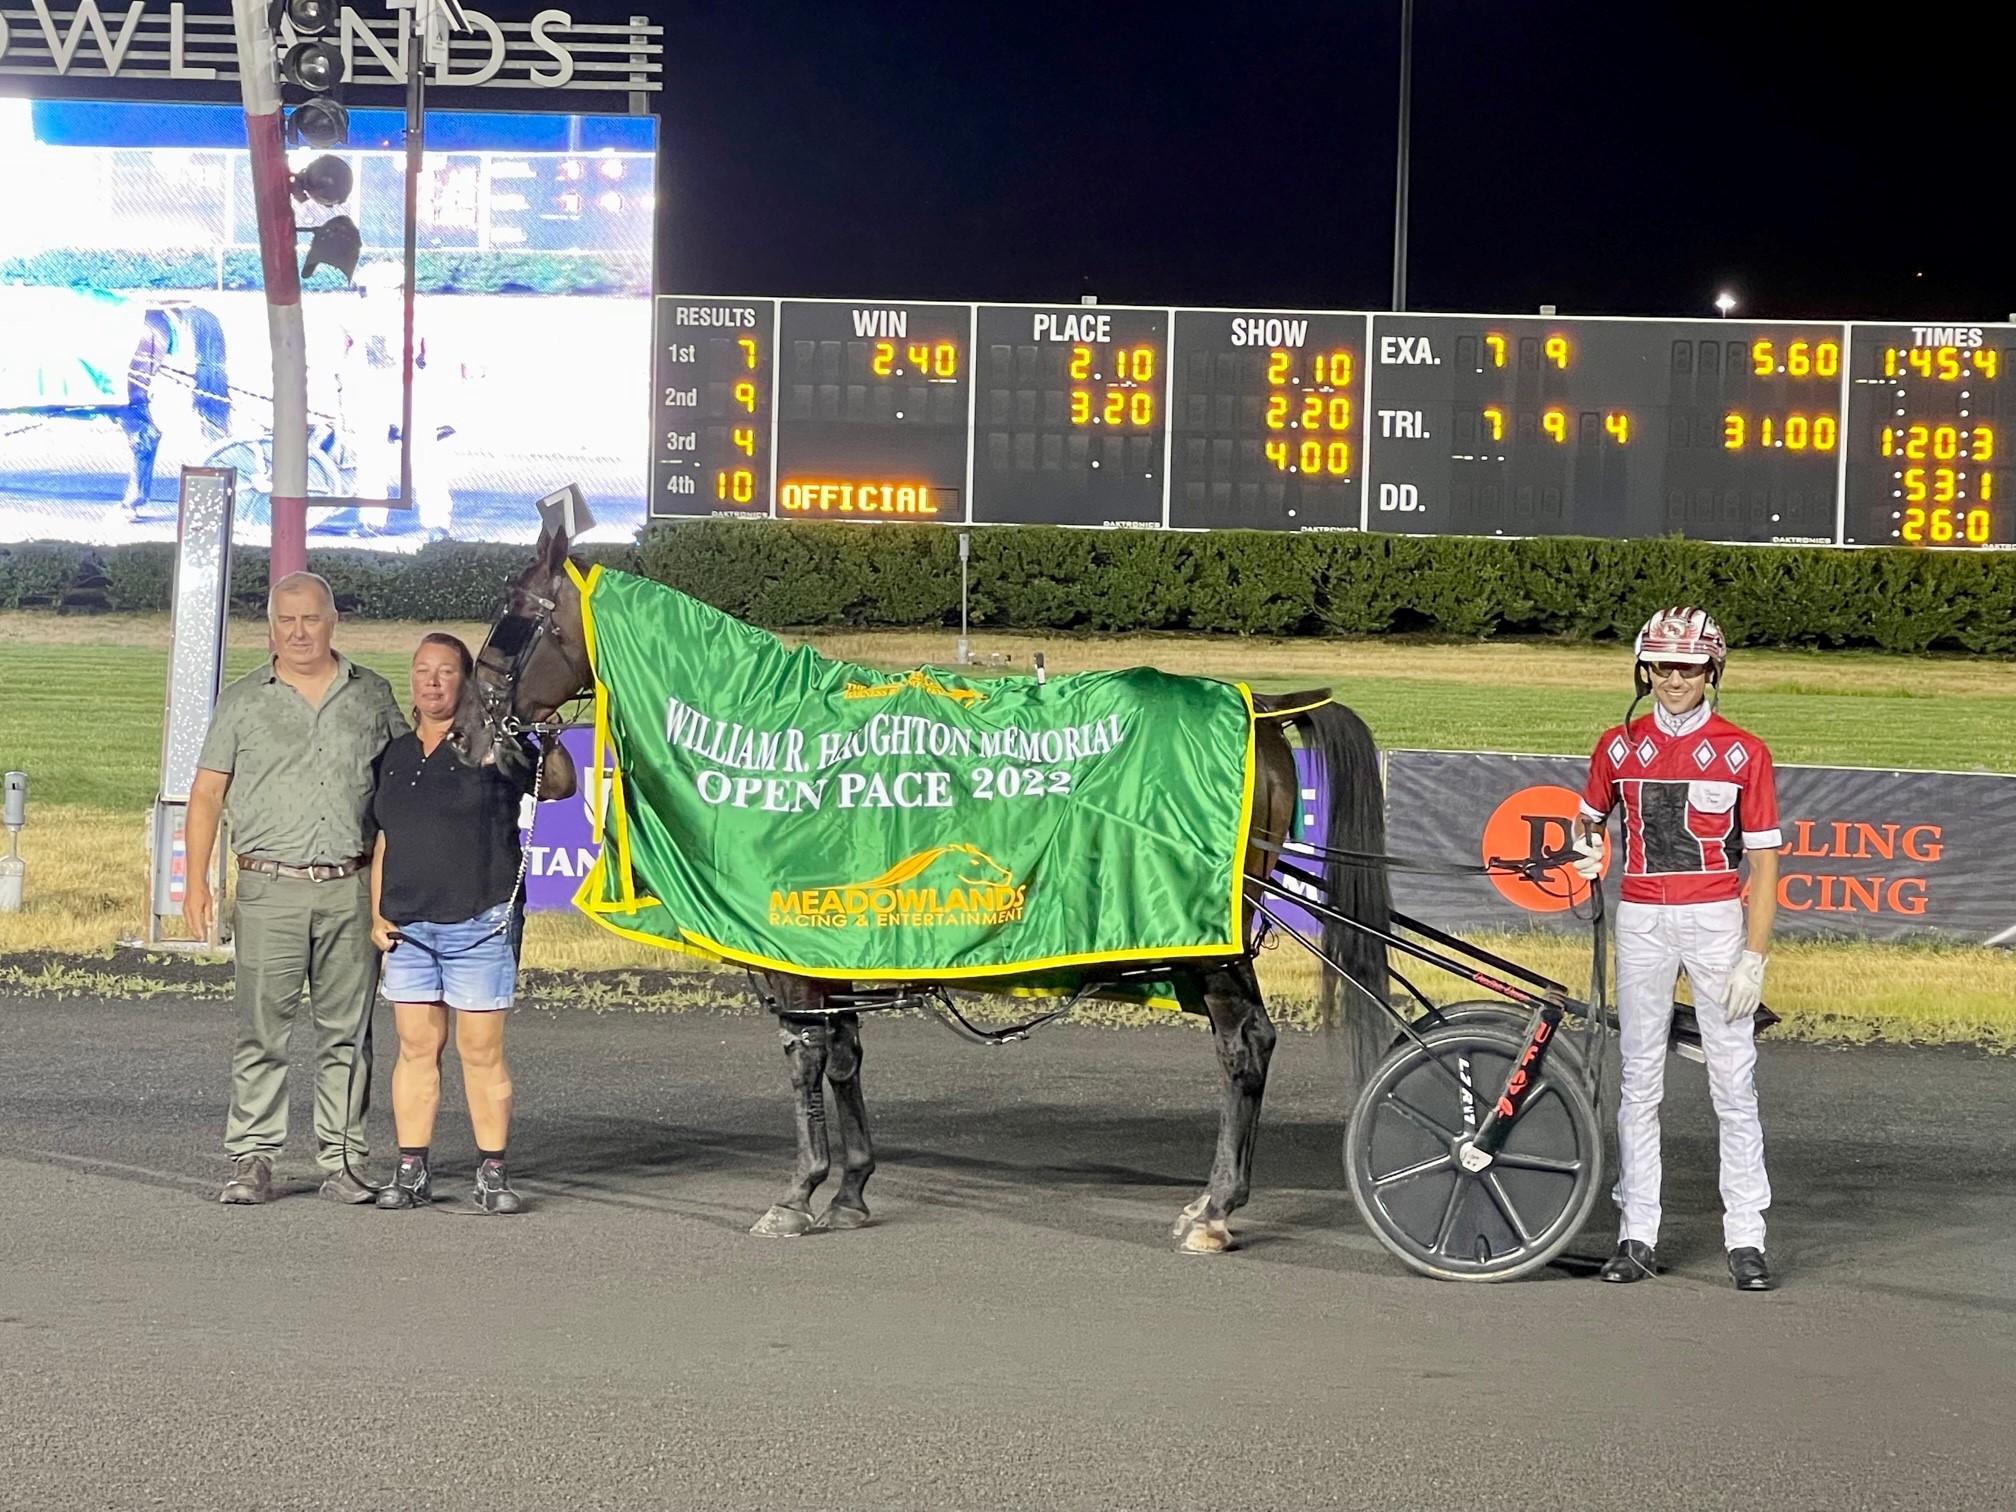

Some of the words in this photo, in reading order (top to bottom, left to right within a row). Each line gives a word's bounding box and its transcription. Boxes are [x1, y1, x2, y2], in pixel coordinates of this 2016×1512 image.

[676, 307, 756, 327] RESULTS
[852, 309, 908, 338] WIN
[1033, 313, 1111, 343] PLACE
[1231, 317, 1308, 348] SHOW
[1380, 336, 1441, 365] EXA.
[1485, 335, 1505, 368] 7
[1545, 337, 1568, 369] 9
[1911, 327, 1983, 347] TIMES
[668, 343, 695, 363] 1st
[737, 338, 756, 370] 7
[872, 342, 956, 376] 2.40
[1068, 346, 1154, 382] 2.10
[1267, 351, 1352, 386] 2.10
[1752, 341, 1839, 376] 5.60
[665, 388, 697, 407] 2nd
[735, 382, 755, 413] 9
[1069, 390, 1152, 426] 3.20
[1265, 396, 1350, 431] 2.20
[1378, 410, 1431, 439] TRI.
[1483, 408, 1503, 441] 7
[1543, 412, 1565, 443] 9
[1605, 412, 1629, 444] 4
[1724, 414, 1837, 451] 31.00
[667, 432, 696, 451] 3rd
[733, 428, 755, 457] 4
[1264, 441, 1349, 475] 4.00
[667, 475, 695, 495] 4th
[717, 470, 753, 503] 10
[781, 483, 938, 514] OFFICIAL
[1379, 483, 1426, 513] DD.
[543, 487, 577, 539] 7
[1103, 520, 1161, 529] DAKTRONICS
[1771, 536, 1831, 544] DAKTRONICS
[666, 696, 782, 771] WILLIAM
[785, 728, 810, 773] R.
[817, 712, 973, 771] HAUGHTON
[978, 713, 1124, 764] MEMORIAL
[697, 770, 829, 813] OPEN
[837, 771, 953, 809] PACE
[971, 766, 1072, 801] 2022
[769, 884, 1027, 915] MEADOWLANDS
[769, 912, 848, 927] RACING
[855, 912, 869, 927] &
[876, 906, 1024, 927] ENTERTAINMENT
